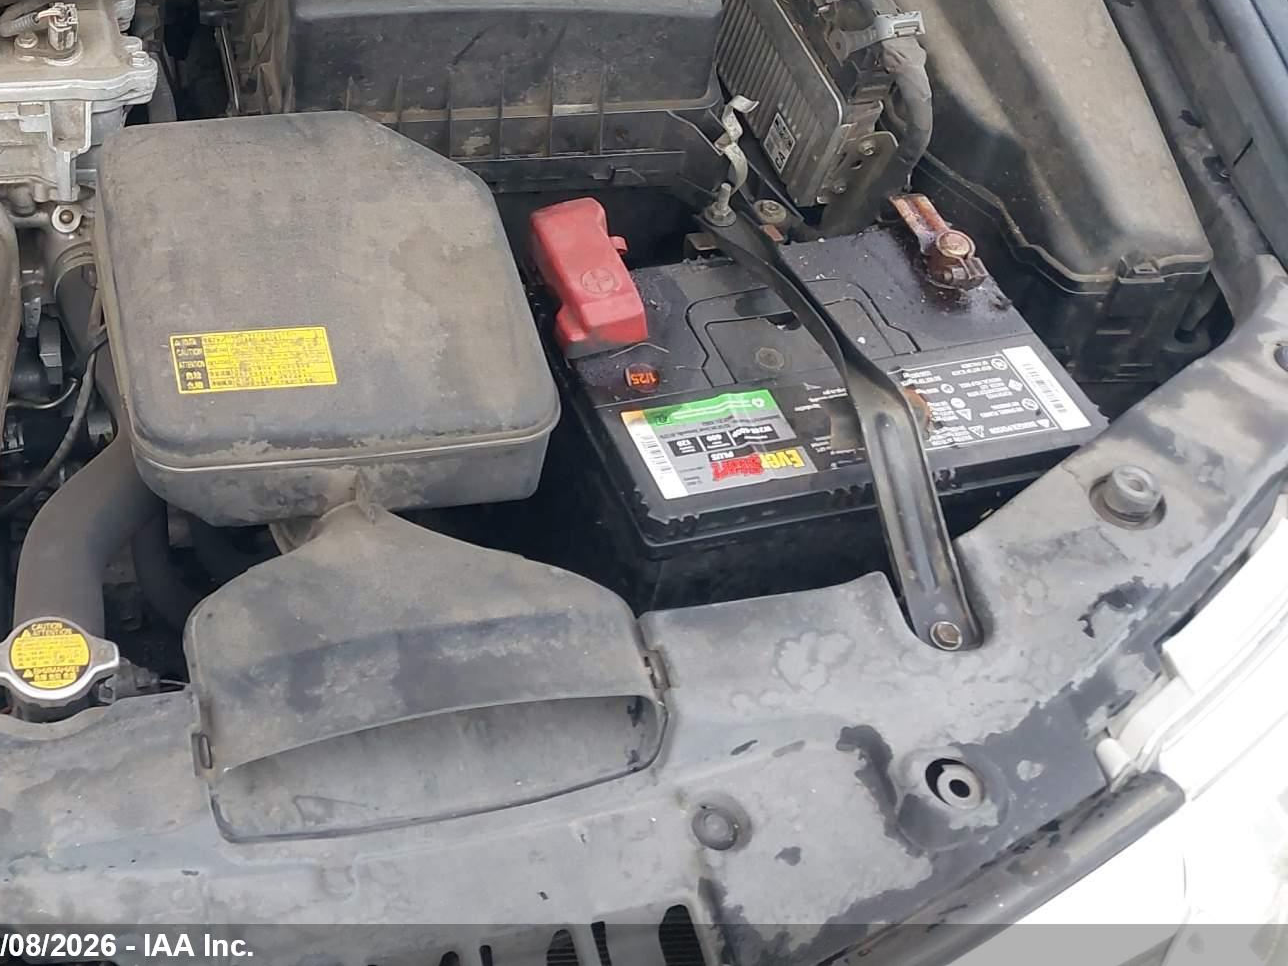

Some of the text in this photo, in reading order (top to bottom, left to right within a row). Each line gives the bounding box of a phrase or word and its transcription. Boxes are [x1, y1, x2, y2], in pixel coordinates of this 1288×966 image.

[630, 372, 657, 386] 1/25
[710, 450, 735, 462] PLUS
[31, 622, 63, 630] CAUTION
